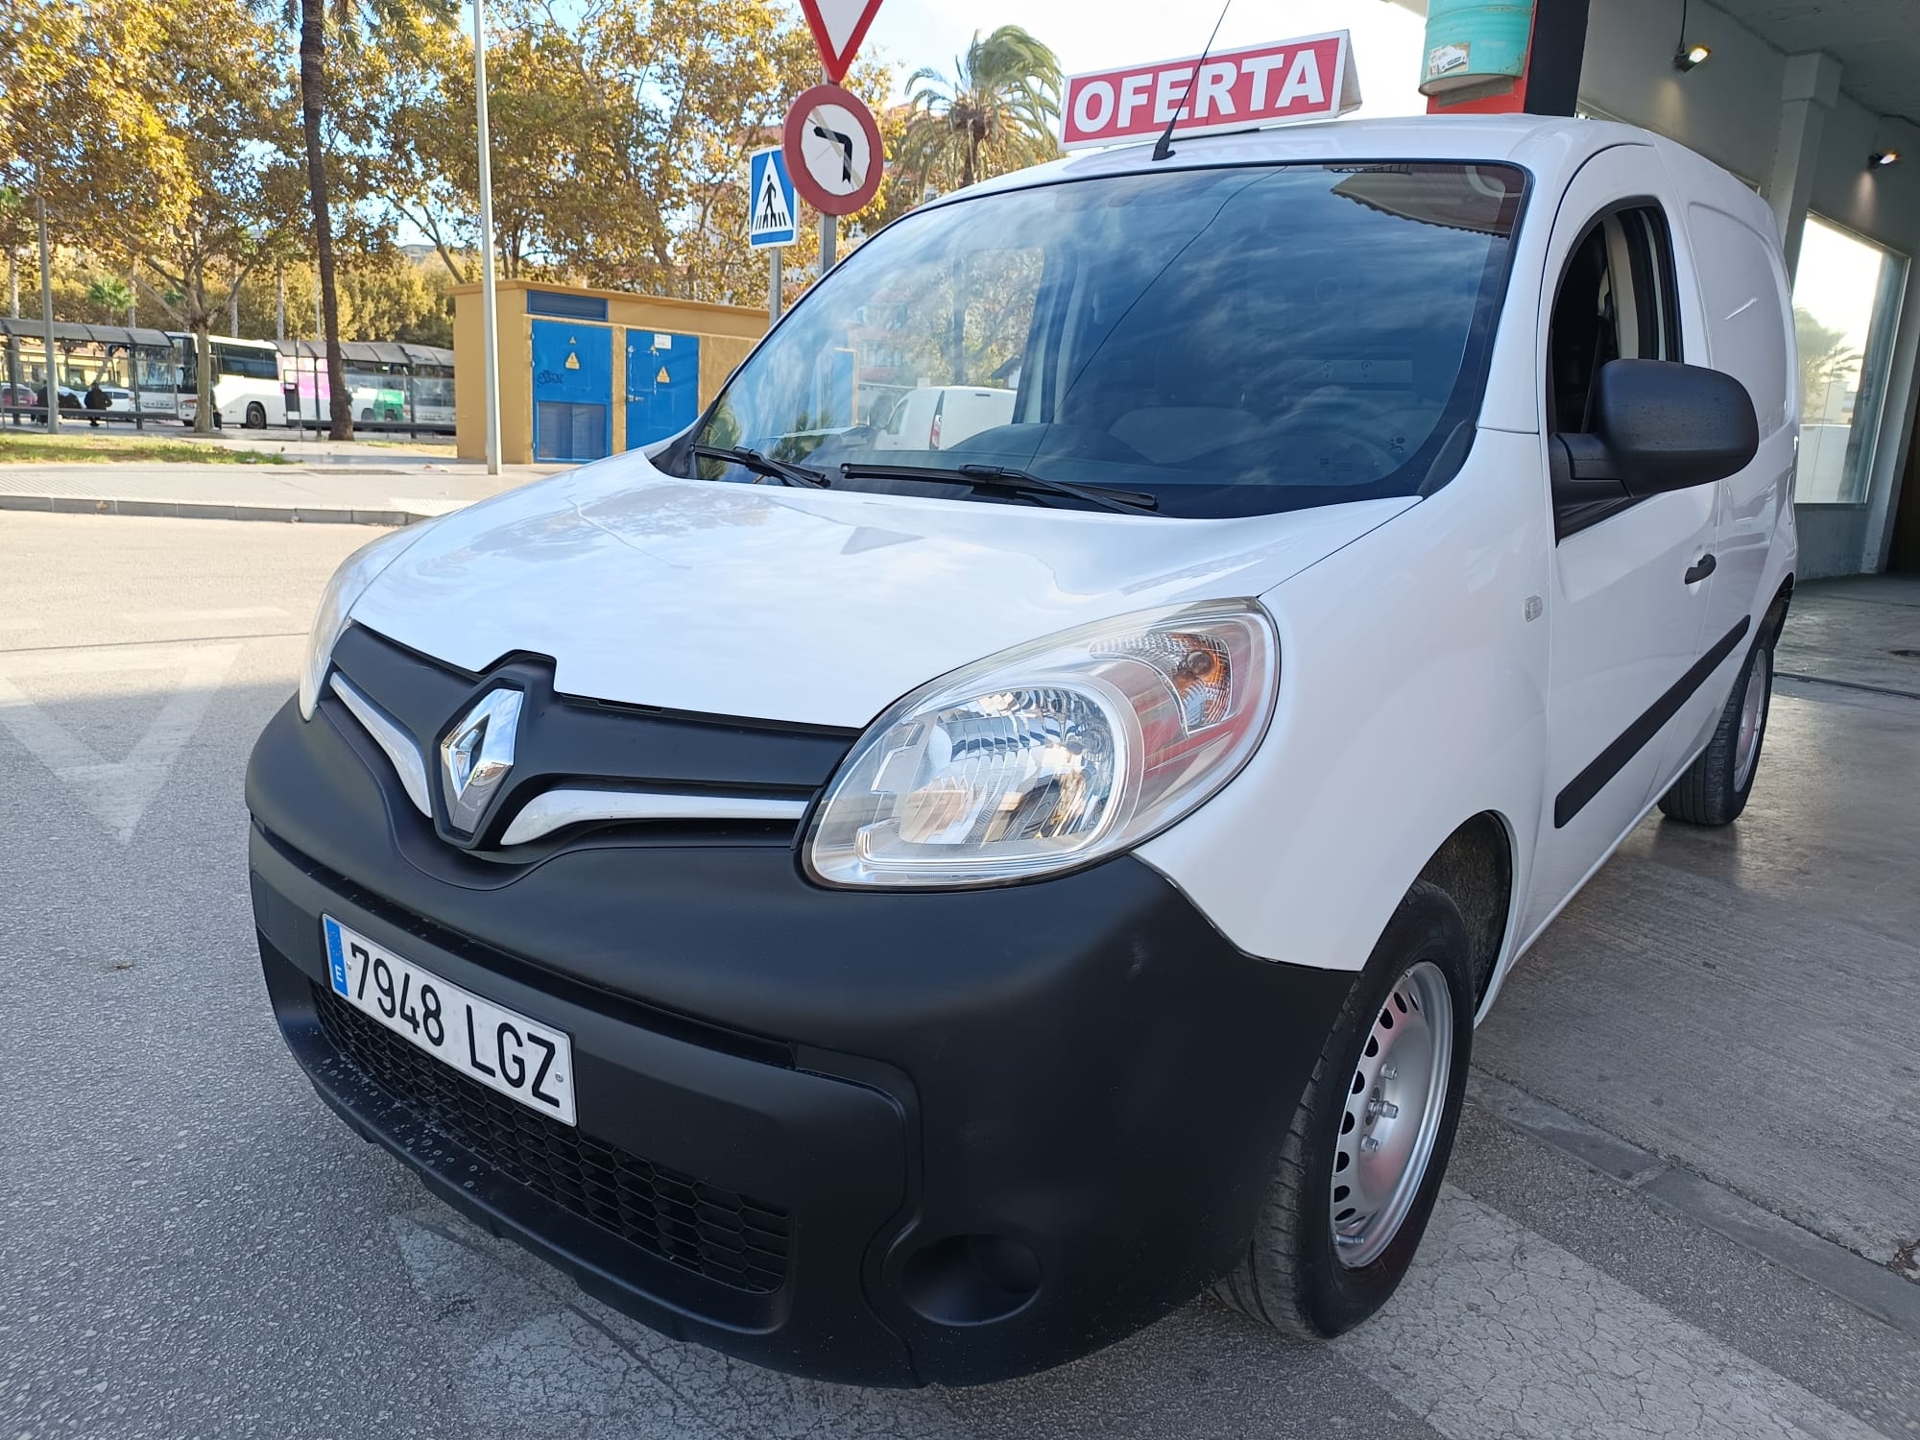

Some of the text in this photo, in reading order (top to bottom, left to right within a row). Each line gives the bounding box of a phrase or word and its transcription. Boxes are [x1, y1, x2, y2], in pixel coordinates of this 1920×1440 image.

[1073, 50, 1325, 133] OFERTA
[335, 965, 343, 982] E
[350, 942, 560, 1108] 7948 LGZ
